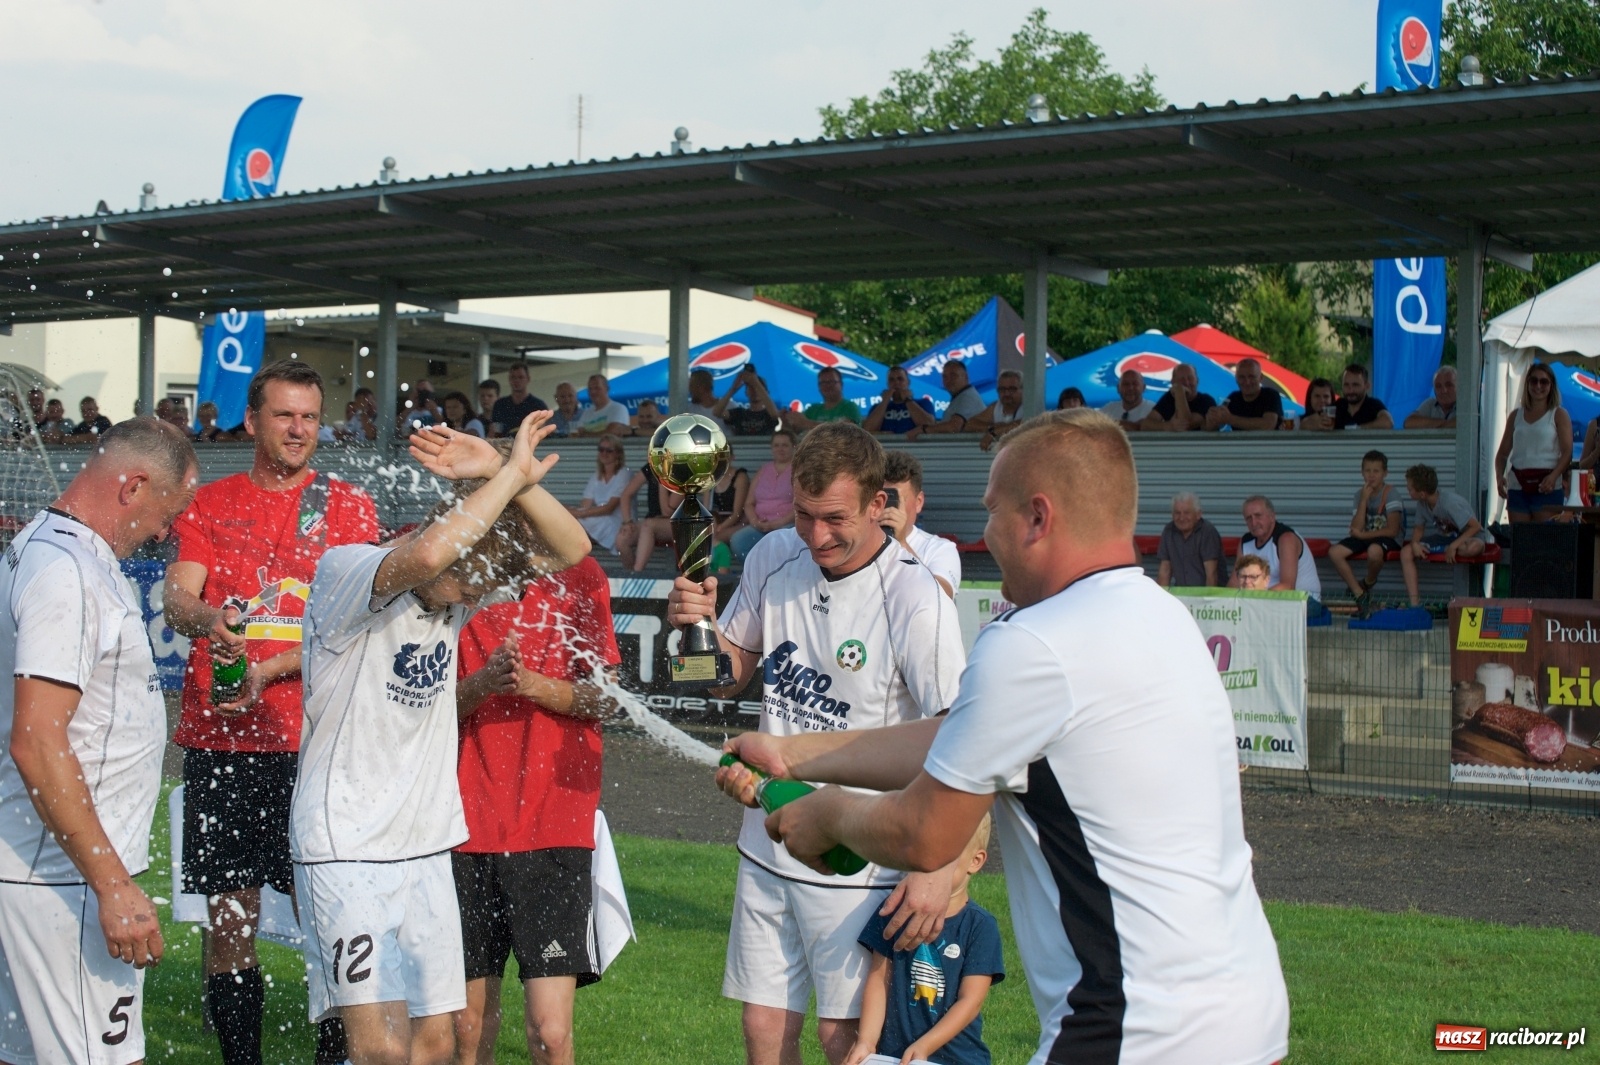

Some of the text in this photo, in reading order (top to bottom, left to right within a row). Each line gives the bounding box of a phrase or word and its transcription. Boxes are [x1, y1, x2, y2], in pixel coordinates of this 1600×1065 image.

[812, 603, 830, 615] erima
[1196, 604, 1242, 626] różnicę!
[772, 680, 851, 719] KANTOR
[837, 721, 848, 730] 40
[1244, 710, 1298, 725] niemożliwe
[332, 933, 374, 986] 12
[541, 950, 568, 959] adidas
[101, 994, 135, 1046] 5
